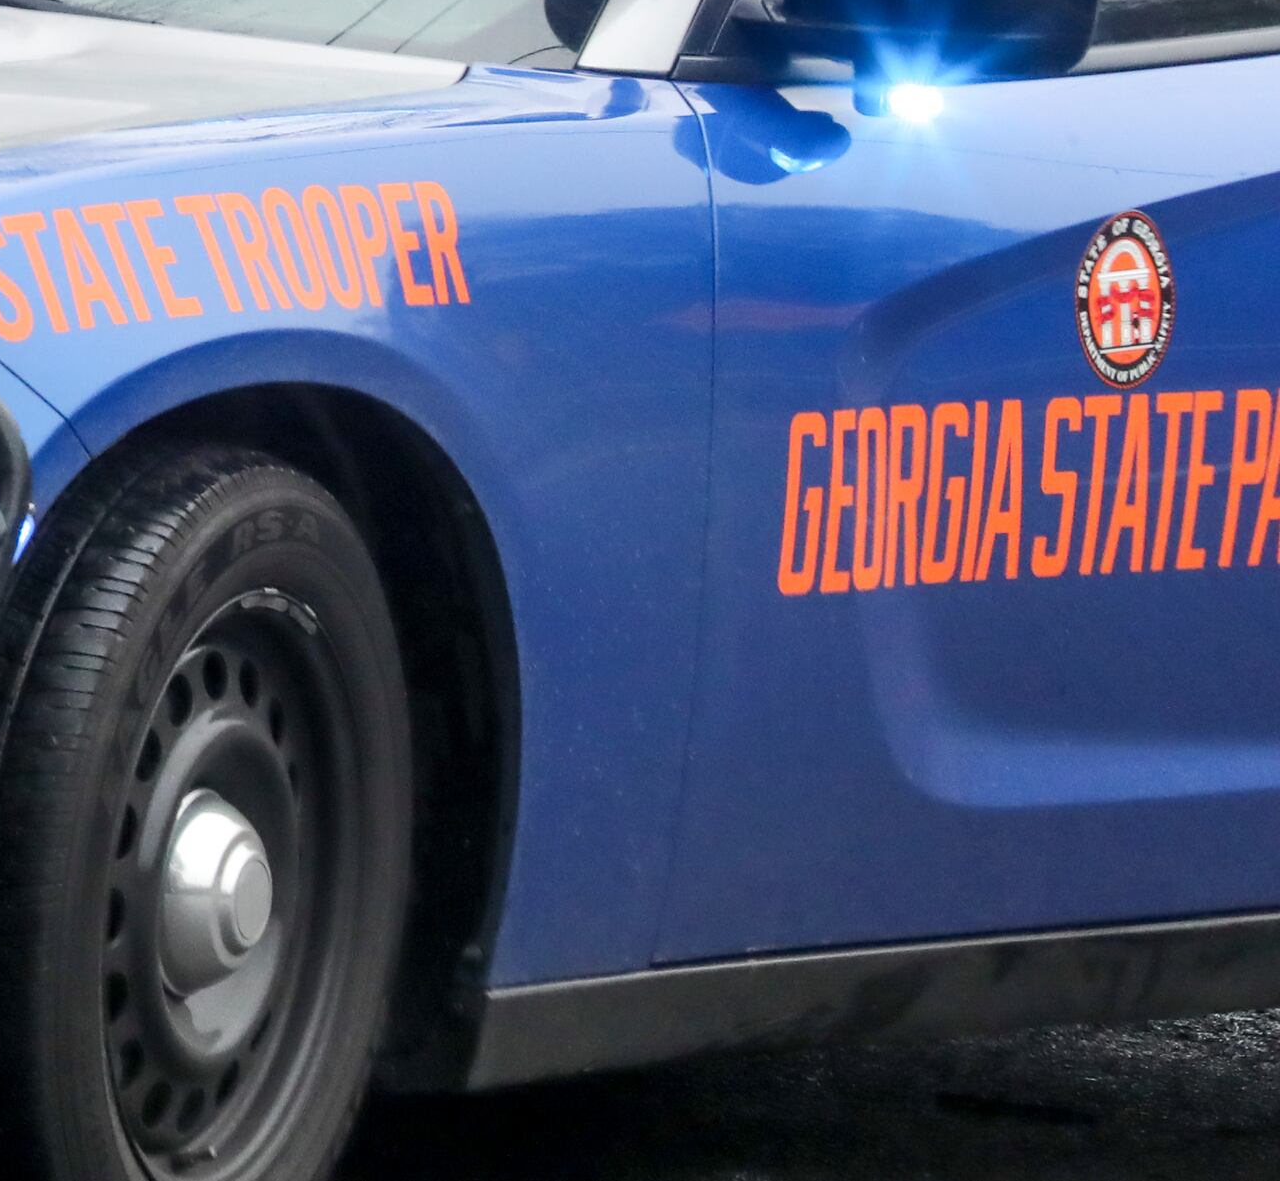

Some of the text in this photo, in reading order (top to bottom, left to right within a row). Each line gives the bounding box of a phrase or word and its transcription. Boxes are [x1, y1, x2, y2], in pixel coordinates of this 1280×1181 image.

[174, 181, 470, 312] TROOPER
[777, 398, 1023, 596] GEORGIA
[1031, 390, 1224, 578] STATE
